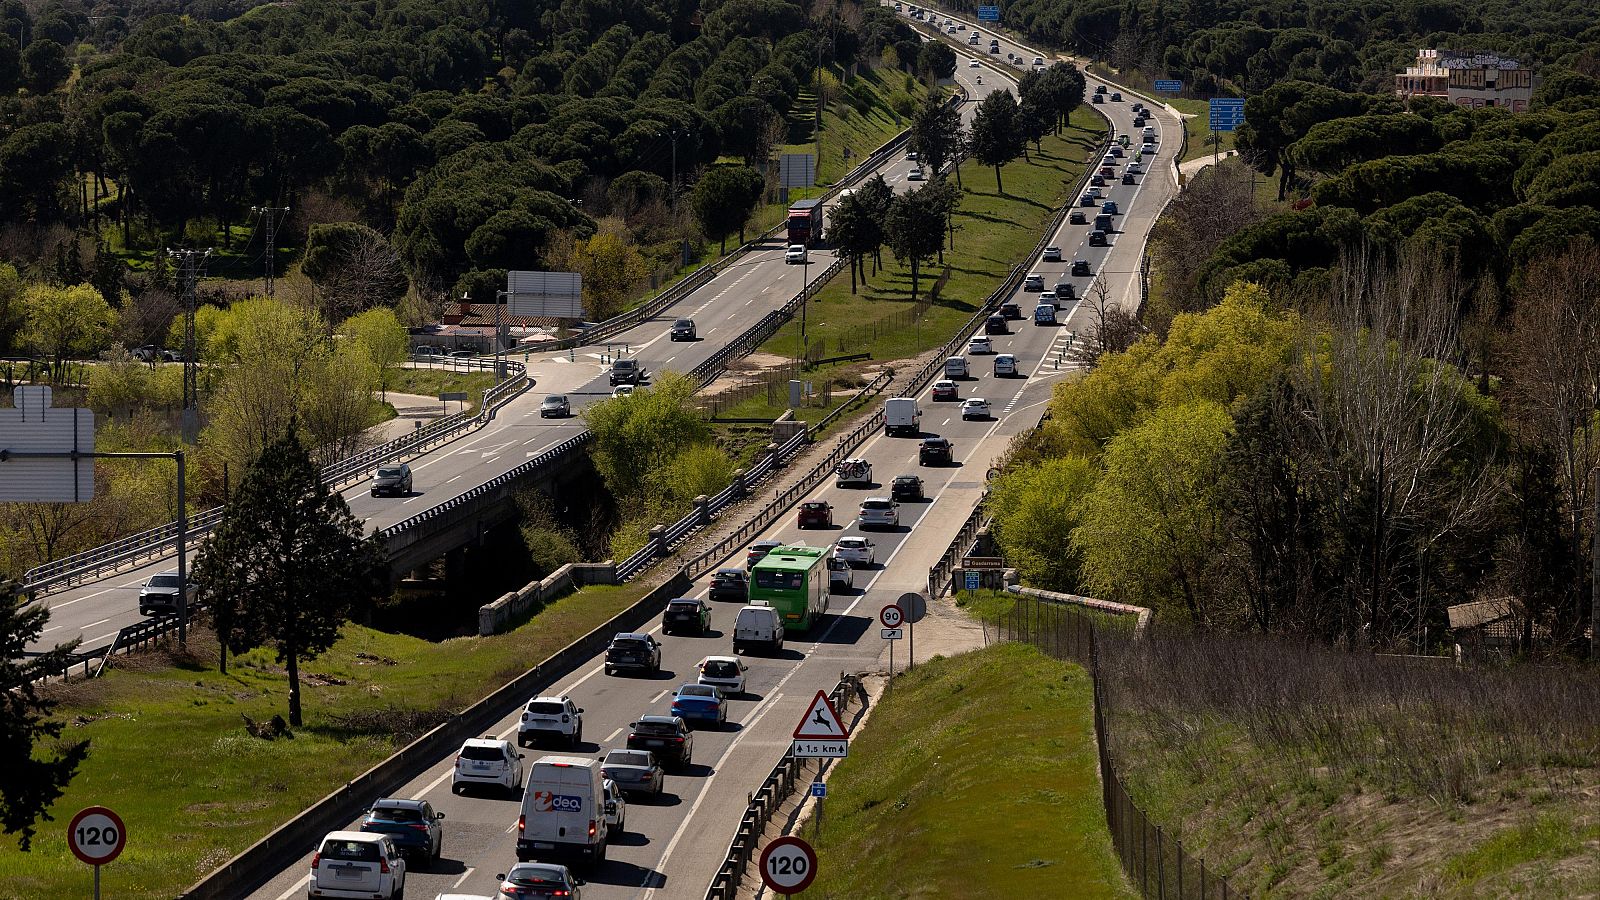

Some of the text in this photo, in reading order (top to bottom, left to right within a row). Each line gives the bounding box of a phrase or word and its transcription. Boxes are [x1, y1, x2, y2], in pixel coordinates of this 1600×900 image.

[885, 612, 899, 621] 90
[822, 744, 837, 753] km
[76, 826, 118, 846] 120
[769, 856, 807, 875] 120
